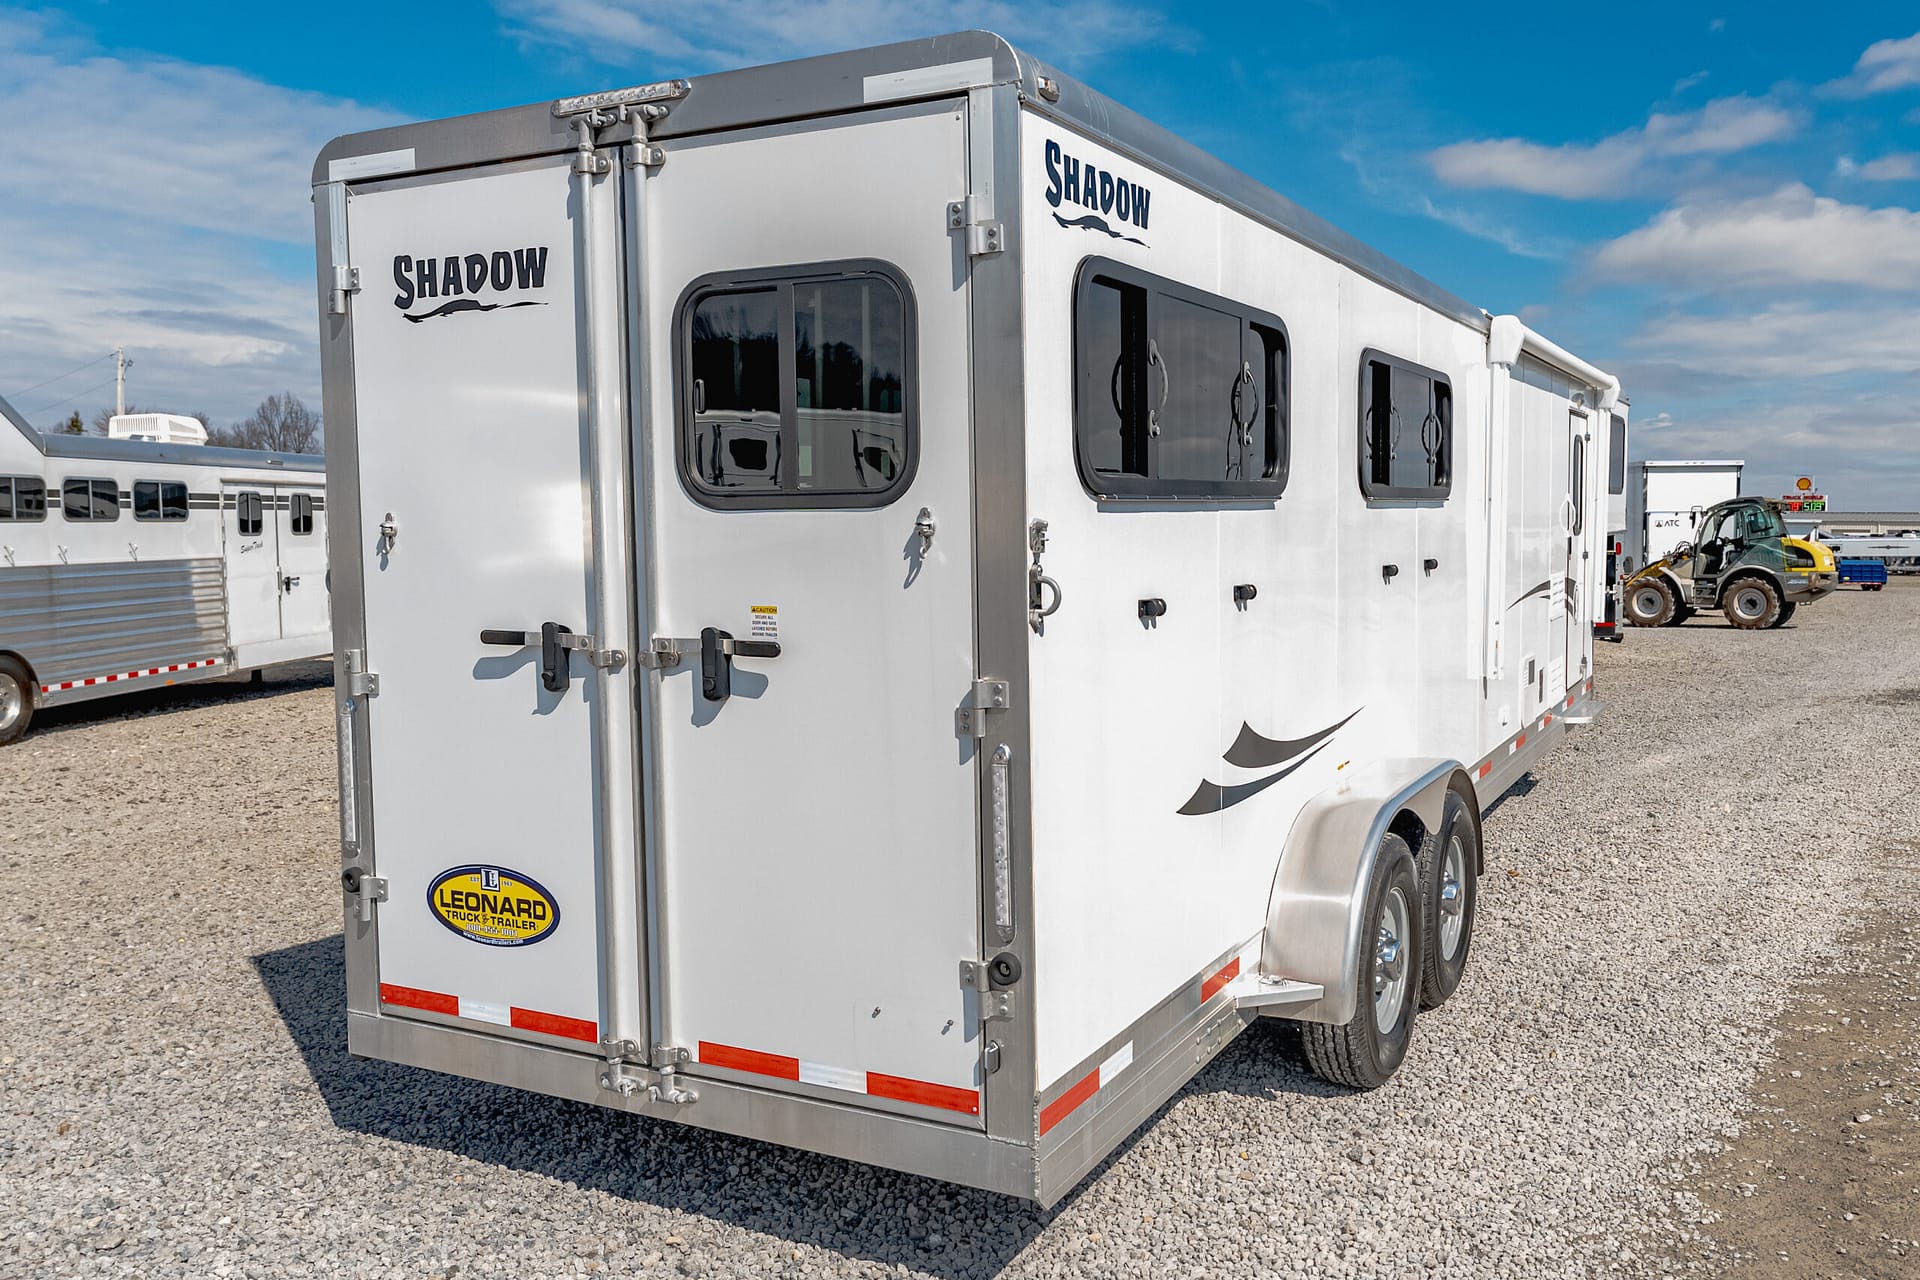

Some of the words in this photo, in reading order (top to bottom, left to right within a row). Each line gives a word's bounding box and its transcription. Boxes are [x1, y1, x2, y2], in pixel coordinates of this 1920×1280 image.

[1045, 139, 1151, 230] SHADOW
[393, 247, 548, 309] SHADOW
[439, 888, 546, 920] LEONARD
[446, 910, 480, 923] TRUCK
[490, 916, 536, 931] TRAILER
